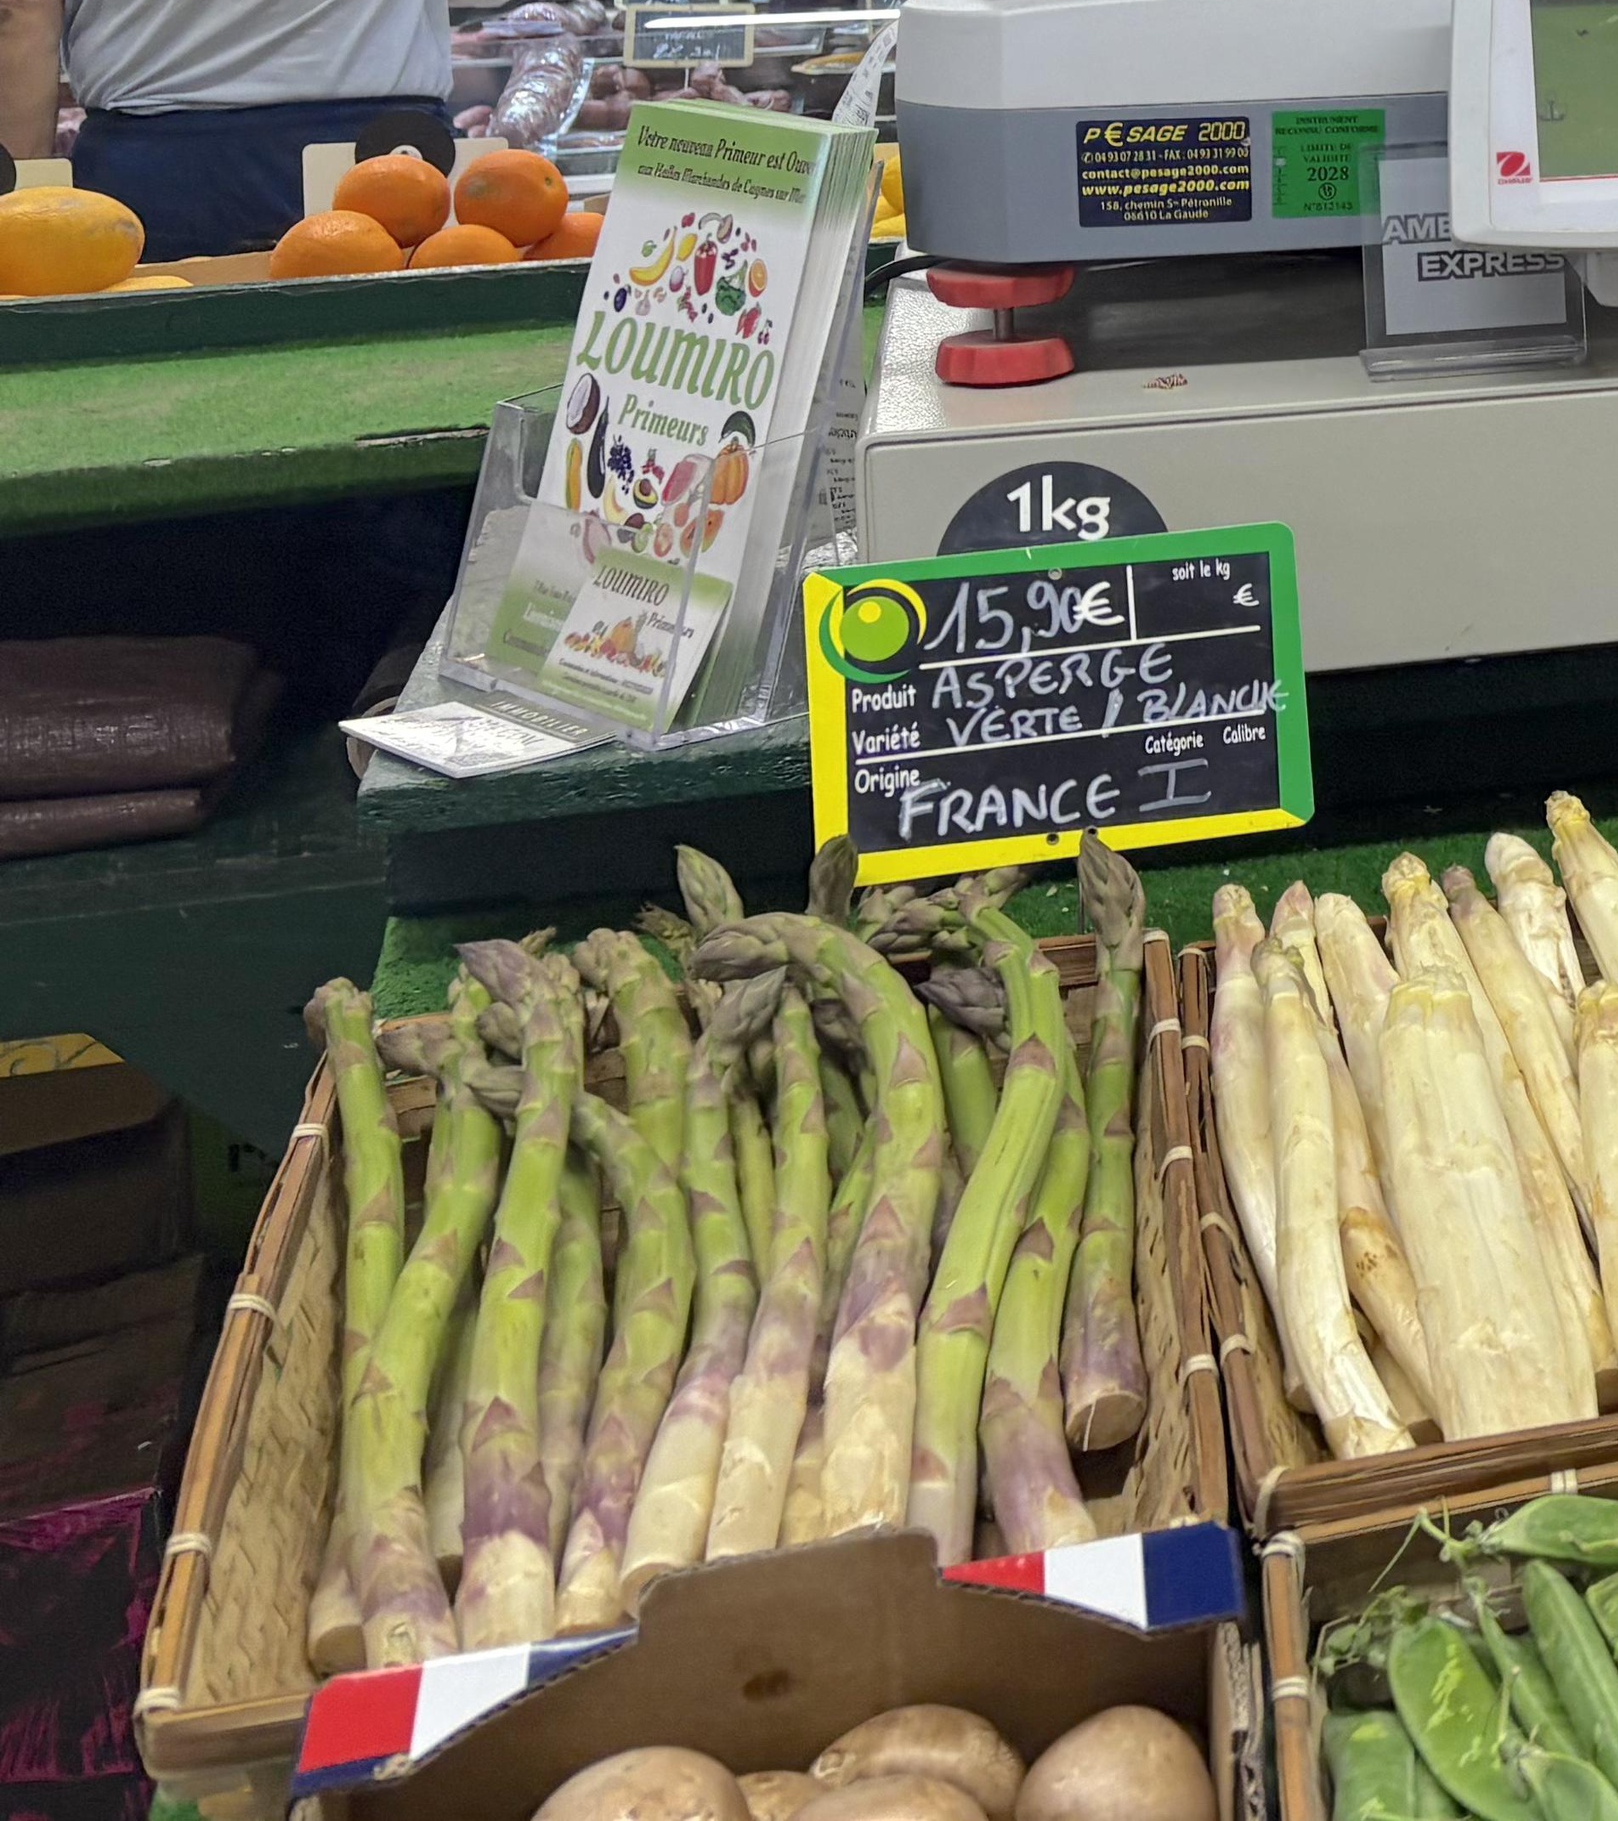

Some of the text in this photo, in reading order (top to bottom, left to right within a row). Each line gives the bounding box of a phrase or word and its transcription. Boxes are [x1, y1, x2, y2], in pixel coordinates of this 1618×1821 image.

[637, 124, 785, 170] Votre nouveau Primeur est
[1198, 121, 1246, 142] 2000
[732, 179, 744, 194] de
[1081, 164, 1249, 180] contact@pesage2000.com
[1306, 165, 1350, 182] 2028
[1081, 180, 1250, 197] www.pesage2000.com
[1124, 199, 1166, 211] chemin
[1159, 209, 1172, 220] La
[1418, 250, 1566, 281] EXPRESS
[576, 310, 776, 411] LOUMIRO
[616, 392, 709, 448] Primeurs
[1005, 474, 1112, 541] 1kg
[923, 580, 1082, 654] 15,90
[930, 642, 1174, 711] ASPERGE
[851, 682, 918, 711] Produit
[851, 721, 922, 752] Variété
[946, 703, 1084, 748] VERTE
[1144, 723, 1267, 756] Catégorie Calibre
[853, 765, 922, 800] Origine
[899, 773, 1121, 842] FRANCE
